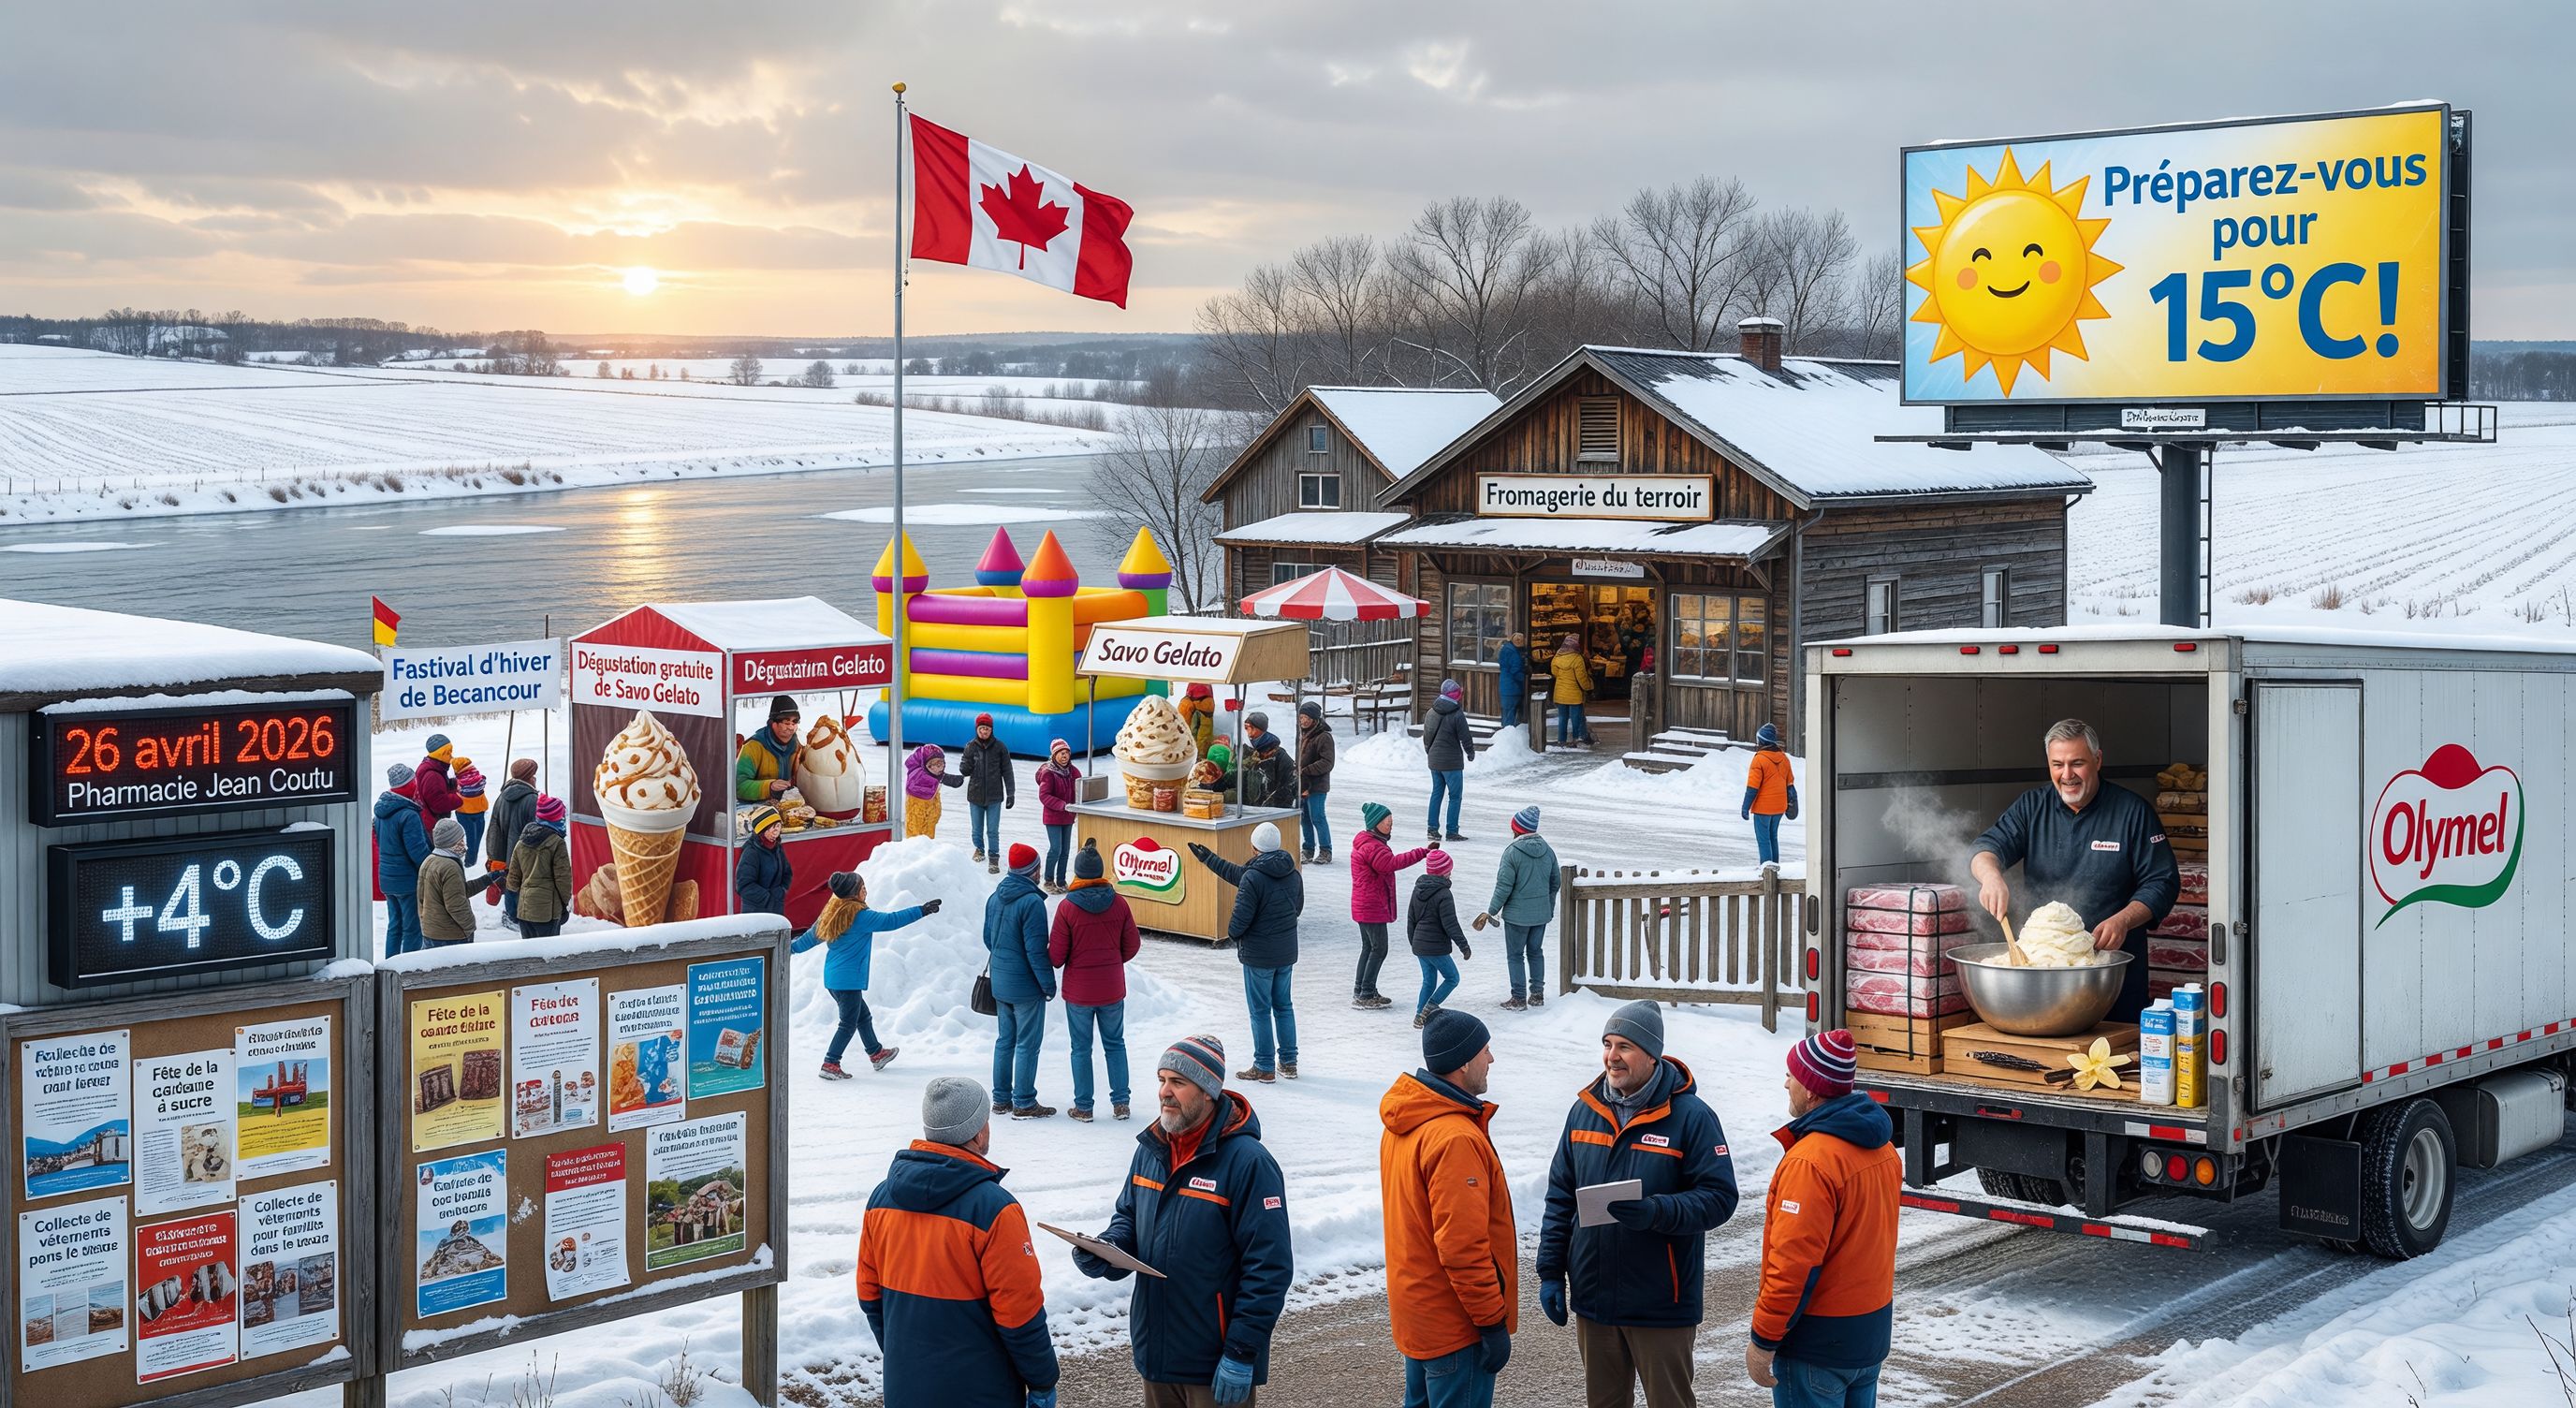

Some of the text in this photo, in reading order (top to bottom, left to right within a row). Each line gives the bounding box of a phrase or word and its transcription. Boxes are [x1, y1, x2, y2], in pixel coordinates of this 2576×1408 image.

[2105, 154, 2426, 213] Préparez-vous
[2213, 213, 2318, 261] pour
[2149, 261, 2399, 362] 15°C!
[1486, 483, 1702, 512] Fromagerie du terroir
[832, 653, 886, 677] Gelato
[1098, 638, 1222, 667] Savo Gelato
[393, 651, 551, 681] Fastival d'hiver
[660, 660, 713, 681] gratuite
[400, 682, 542, 708] de Becancour
[594, 678, 700, 705] de Savo Gelato
[66, 715, 334, 774] 26 avril 2026
[67, 767, 333, 808] Pharmacie Jean Coutu
[2383, 792, 2508, 880] Olymel
[102, 855, 303, 948] +4°C
[461, 1005, 476, 1018] de
[479, 1004, 490, 1016] la
[153, 1061, 218, 1080] Fête de la
[158, 1096, 212, 1113] à sucre
[308, 1193, 322, 1203] de
[35, 1210, 111, 1232] Collecte de
[253, 1230, 279, 1243] pour
[283, 1239, 294, 1250] le
[66, 1247, 79, 1259] le
